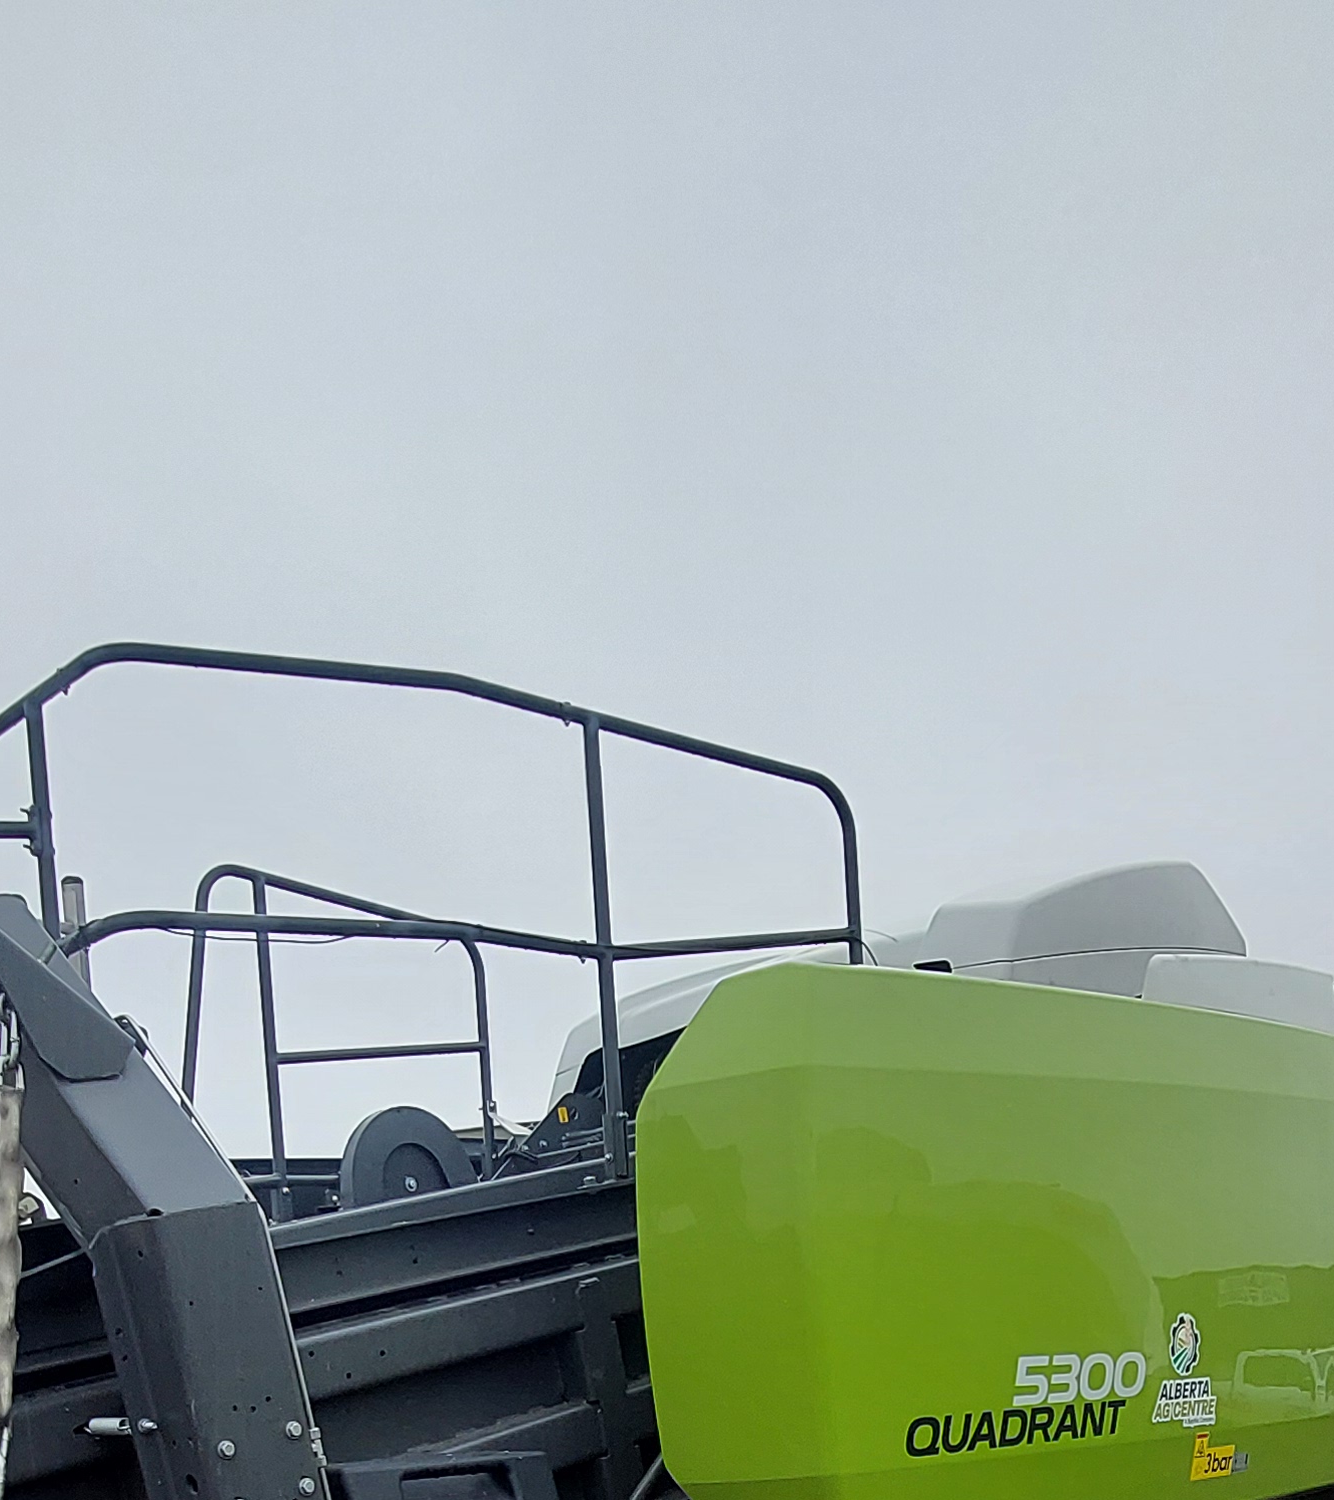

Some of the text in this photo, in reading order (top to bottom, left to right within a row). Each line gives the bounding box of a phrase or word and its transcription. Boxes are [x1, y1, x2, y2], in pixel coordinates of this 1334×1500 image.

[1012, 1352, 1147, 1406] 5300
[1159, 1380, 1210, 1401] ALBERTA
[905, 1399, 1127, 1457] QUADRANT
[1154, 1399, 1215, 1420] AG CENTRE
